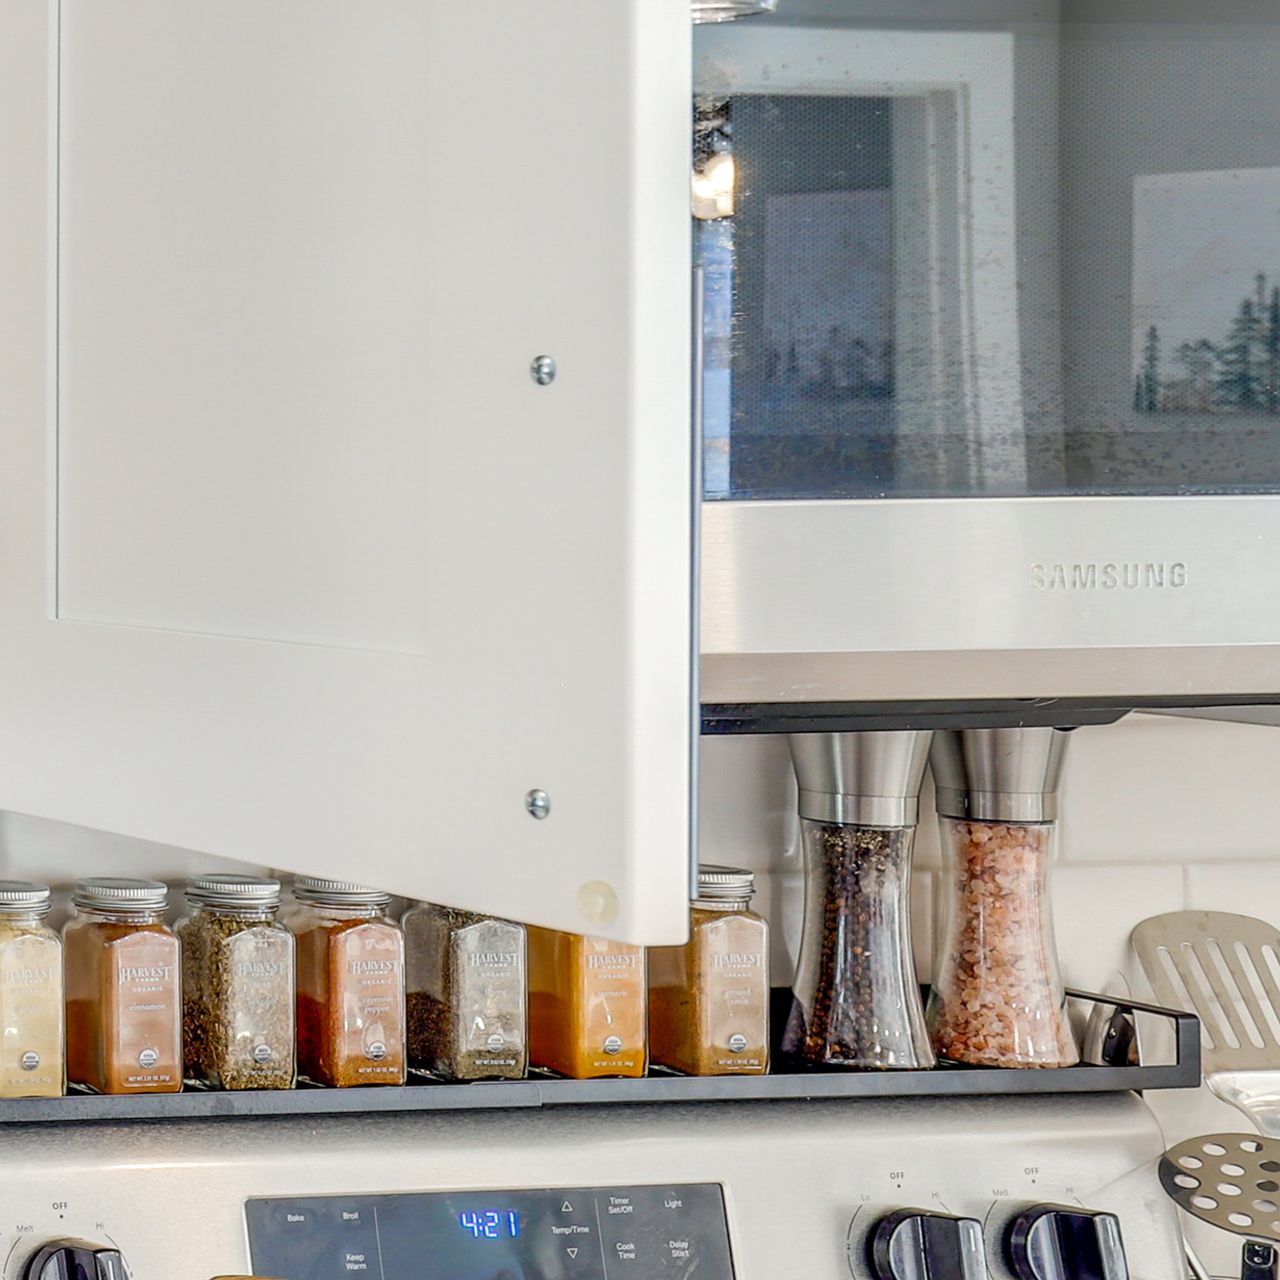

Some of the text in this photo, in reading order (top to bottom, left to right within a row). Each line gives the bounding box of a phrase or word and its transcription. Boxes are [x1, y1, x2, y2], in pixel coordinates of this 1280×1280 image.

[1030, 562, 1188, 590] SAMSUNG
[472, 952, 518, 967] HARVEST
[589, 954, 637, 969] HARVEST
[713, 953, 760, 967] HARVEST
[238, 961, 283, 976] HARVEST
[352, 959, 400, 975] HARVEST
[120, 966, 172, 984] HARVEST
[129, 1003, 166, 1011] cinnamon
[1024, 1167, 1040, 1175] OFF
[889, 1172, 905, 1180] OFF
[861, 1194, 870, 1202] Lo
[53, 1202, 68, 1210] OFF
[665, 1200, 682, 1209] Light
[608, 1206, 633, 1214] Set/Off
[287, 1214, 304, 1222] Bake
[343, 1212, 359, 1220] Broil
[16, 1224, 34, 1233] Melt
[96, 1222, 105, 1230] Hi
[461, 1211, 517, 1238] 4:21
[551, 1226, 589, 1235] Temp/Time
[669, 1241, 689, 1249] Delay
[346, 1254, 365, 1262] Keep
[672, 1250, 689, 1258] Start
[345, 1262, 367, 1271] Warm
